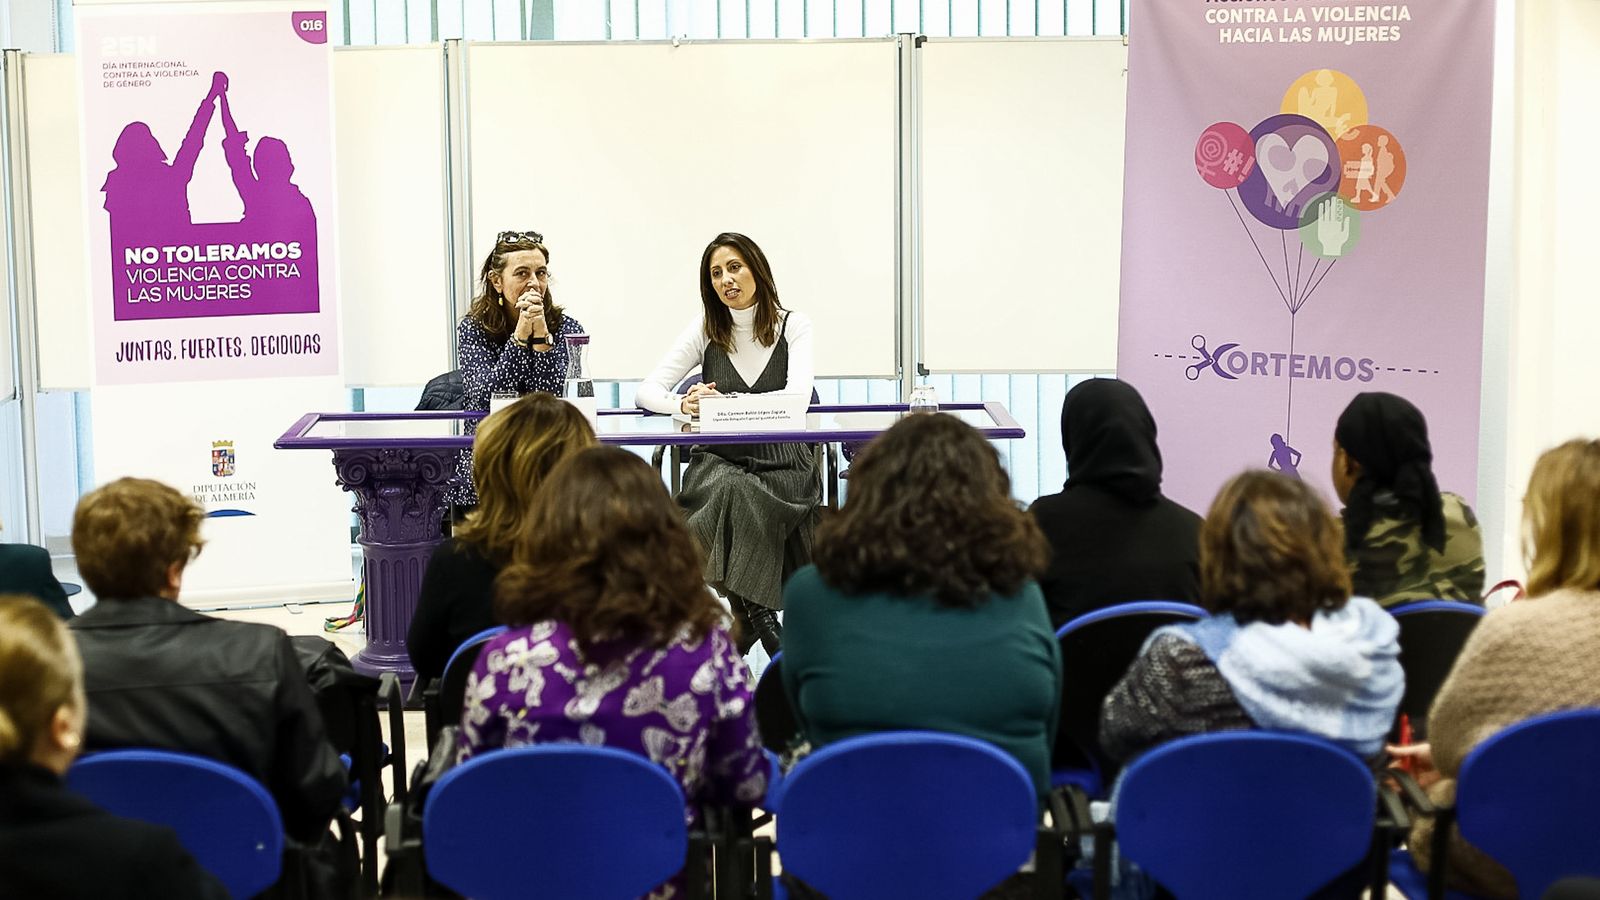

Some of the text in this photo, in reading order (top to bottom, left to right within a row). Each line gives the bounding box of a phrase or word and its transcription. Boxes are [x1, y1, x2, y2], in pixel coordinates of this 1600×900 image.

[1205, 5, 1411, 24] CONTRA LA VIOLENCIA
[300, 19, 323, 31] 016
[1219, 26, 1401, 45] HACIA LAS MUJERES
[101, 35, 157, 57] 25N
[102, 61, 188, 70] DÍA INTERNACIONAL
[103, 71, 138, 79] CONTRA
[153, 69, 200, 78] VIOLENCIA
[116, 80, 152, 88] GÉNERO
[125, 242, 302, 264] NO TOLERAMOS
[126, 263, 300, 284] VIOLENCIA CONTRA
[127, 283, 252, 303] LAS MUJERES
[116, 333, 321, 362] JUNTAS, FUERTES, DECIDIDAS
[193, 481, 256, 493] DIPUTACIÓN
[211, 491, 255, 502] ALMERÍA
